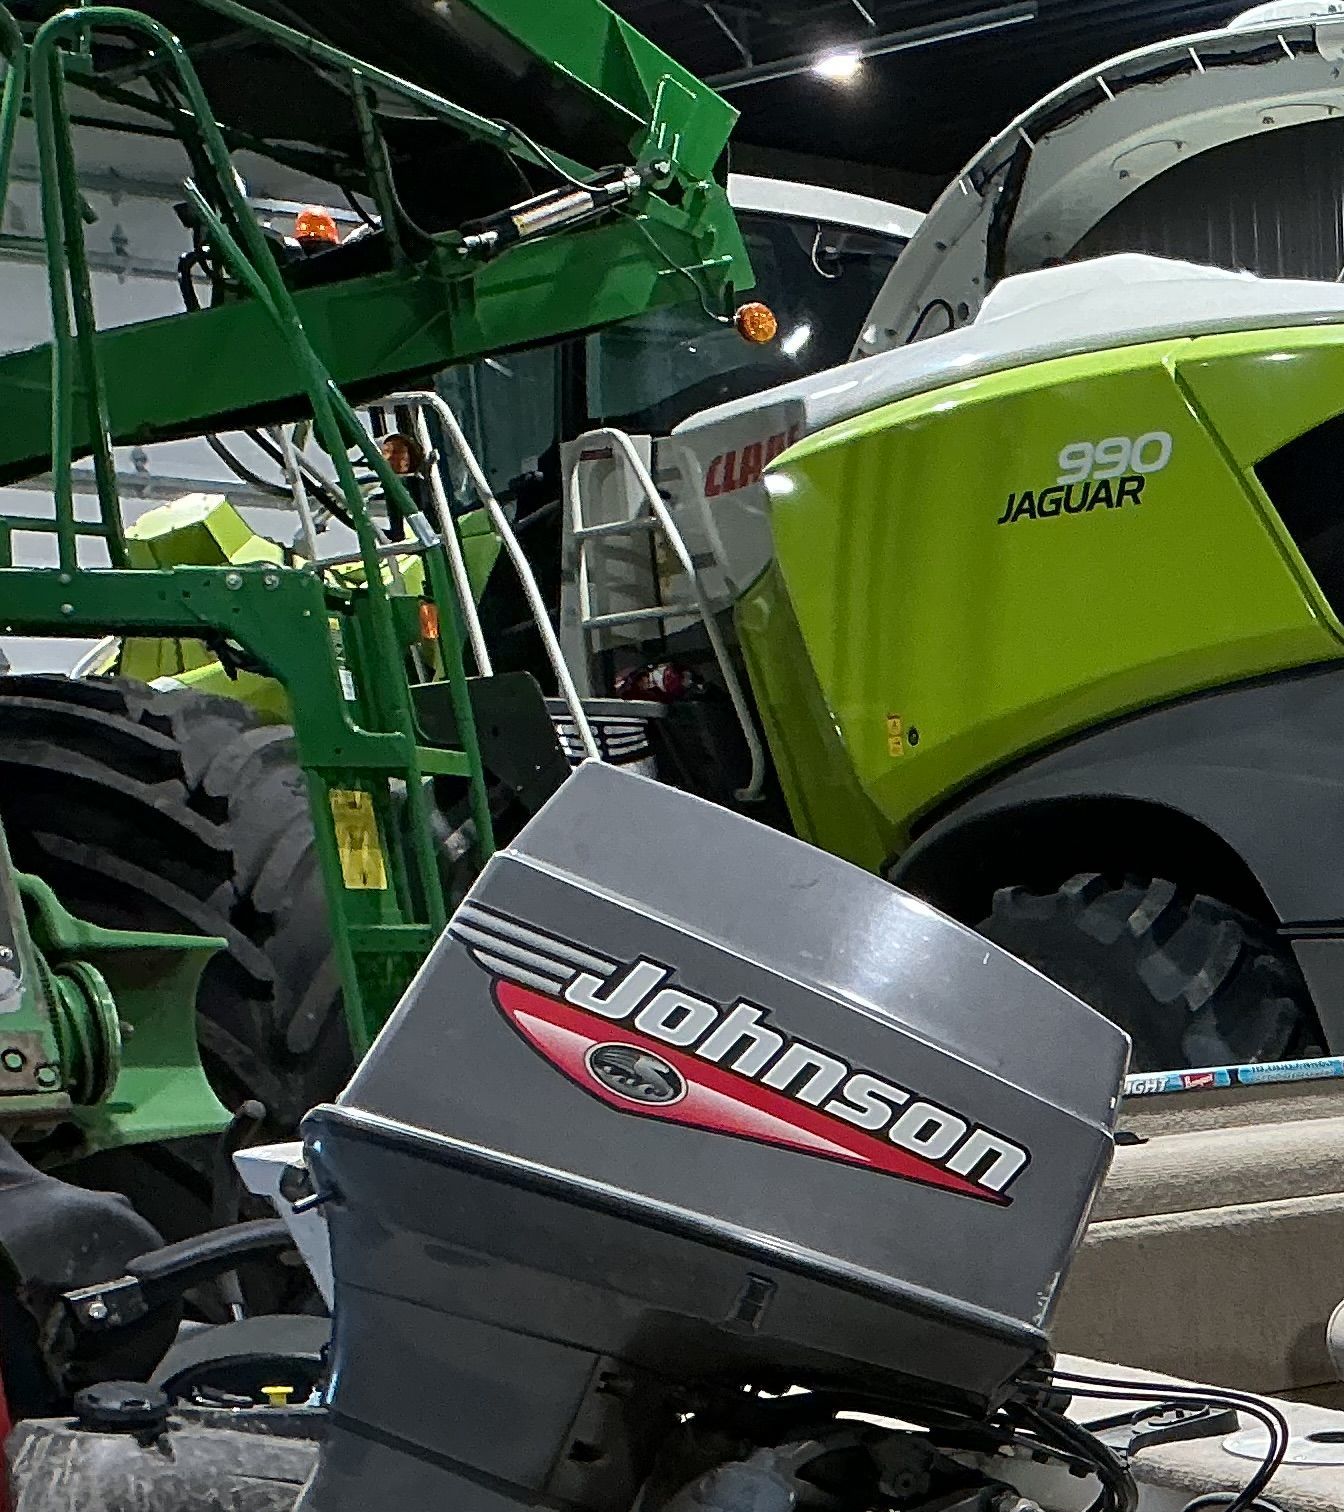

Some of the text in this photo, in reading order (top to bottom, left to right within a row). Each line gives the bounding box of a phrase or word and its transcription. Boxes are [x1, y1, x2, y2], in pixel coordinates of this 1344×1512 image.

[1056, 431, 1173, 486] 990
[997, 474, 1146, 525] JAGUAR
[563, 957, 1030, 1193] Johnson
